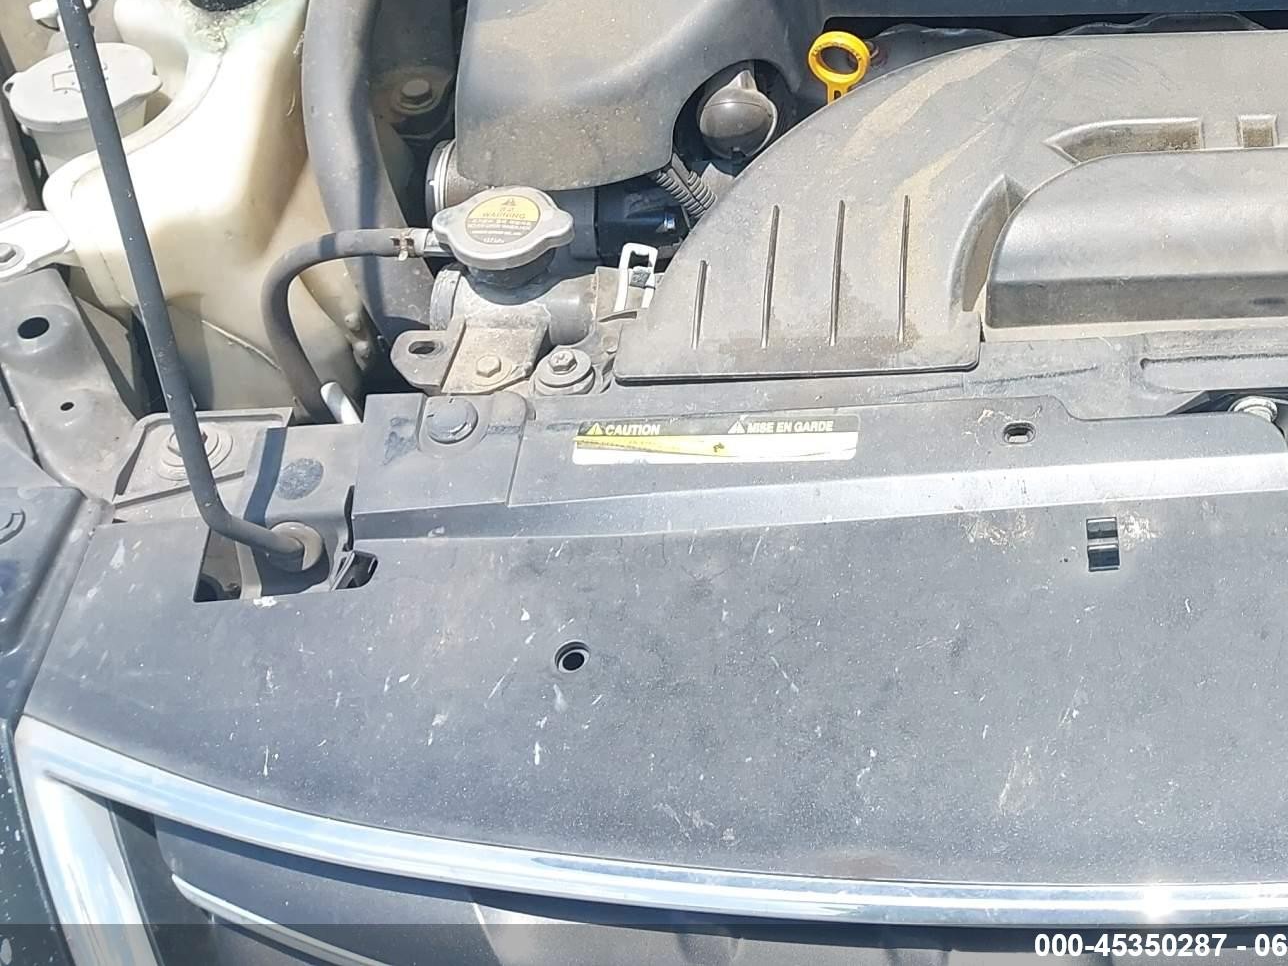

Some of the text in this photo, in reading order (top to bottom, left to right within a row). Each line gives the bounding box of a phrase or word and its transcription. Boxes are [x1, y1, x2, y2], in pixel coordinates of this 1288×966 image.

[604, 424, 662, 436] CAUTION
[747, 420, 834, 434] MISE EN GARDE
